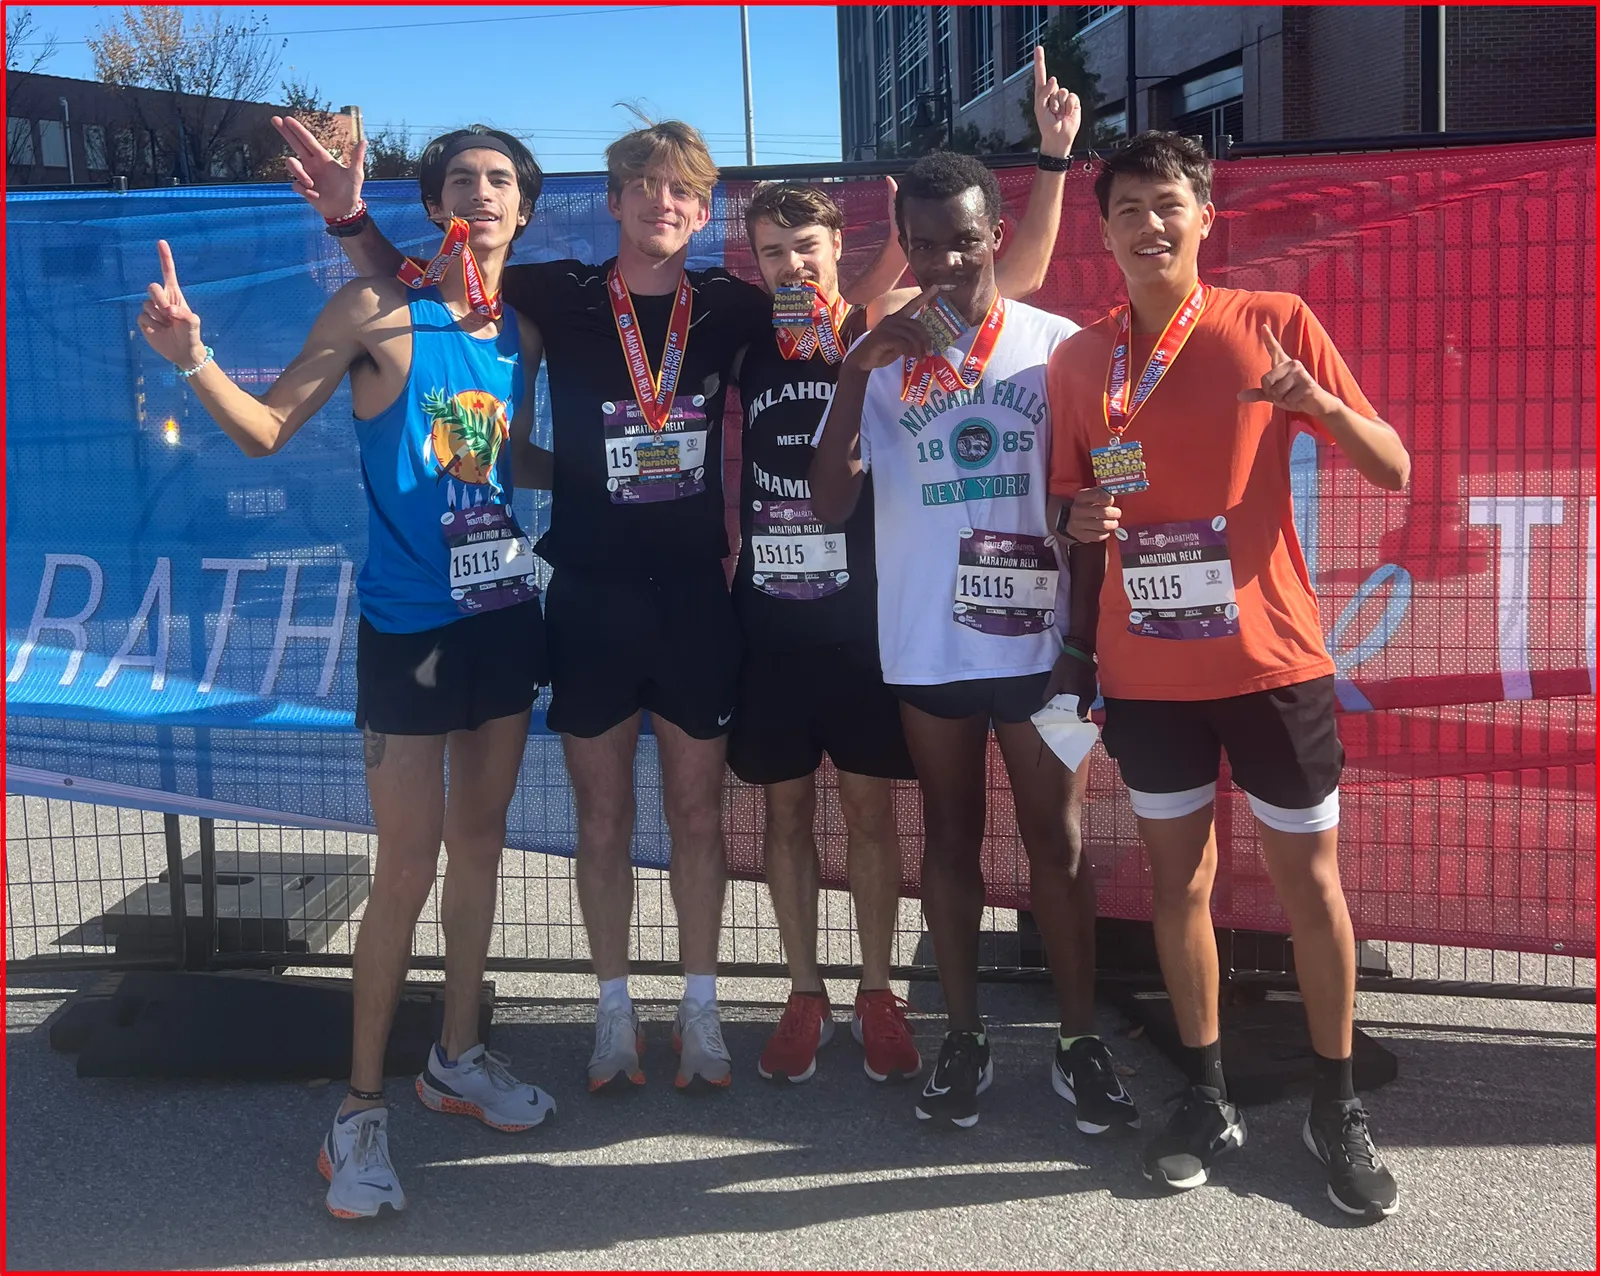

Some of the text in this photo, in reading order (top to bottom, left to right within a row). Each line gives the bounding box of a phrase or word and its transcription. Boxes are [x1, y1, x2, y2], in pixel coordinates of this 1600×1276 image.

[774, 293, 801, 301] Route
[773, 302, 815, 311] Marathon
[819, 307, 835, 345] WILLIAMS
[624, 329, 653, 404] MARATHON RELAY
[968, 355, 978, 365] 66
[1144, 359, 1160, 382] ROUTE
[1156, 349, 1166, 359] 66
[656, 332, 678, 405] WILLIAMS ROUTE 66
[667, 349, 682, 392] MARATHON
[937, 366, 959, 391] RELAY
[748, 381, 836, 429] OKLAHO
[899, 379, 1047, 438] NIAGARA FALLS
[665, 421, 685, 432] RELAY
[777, 434, 811, 446] MEET
[917, 430, 1035, 463] 18 85
[637, 447, 680, 458] Route 66
[1091, 449, 1142, 467] Route 66
[638, 458, 680, 467] Marathon
[1093, 462, 1146, 478] Marathon
[1100, 476, 1126, 485] MARATHON
[924, 475, 1028, 504] NEW YORK
[769, 511, 784, 519] ROUTE
[466, 530, 500, 543] MARATHON
[768, 524, 823, 534] MARATHON RELAY
[983, 541, 1001, 550] ROUTE
[1139, 537, 1156, 547] ROUTE
[1165, 533, 1199, 545] MARATHON
[756, 544, 805, 565] 15115
[979, 555, 1039, 568] MARATHON RELAY
[1139, 549, 1202, 565] MARATHON RELAY
[453, 549, 500, 579] 15115
[960, 574, 1014, 599] 15115
[1127, 575, 1182, 600] 15115
